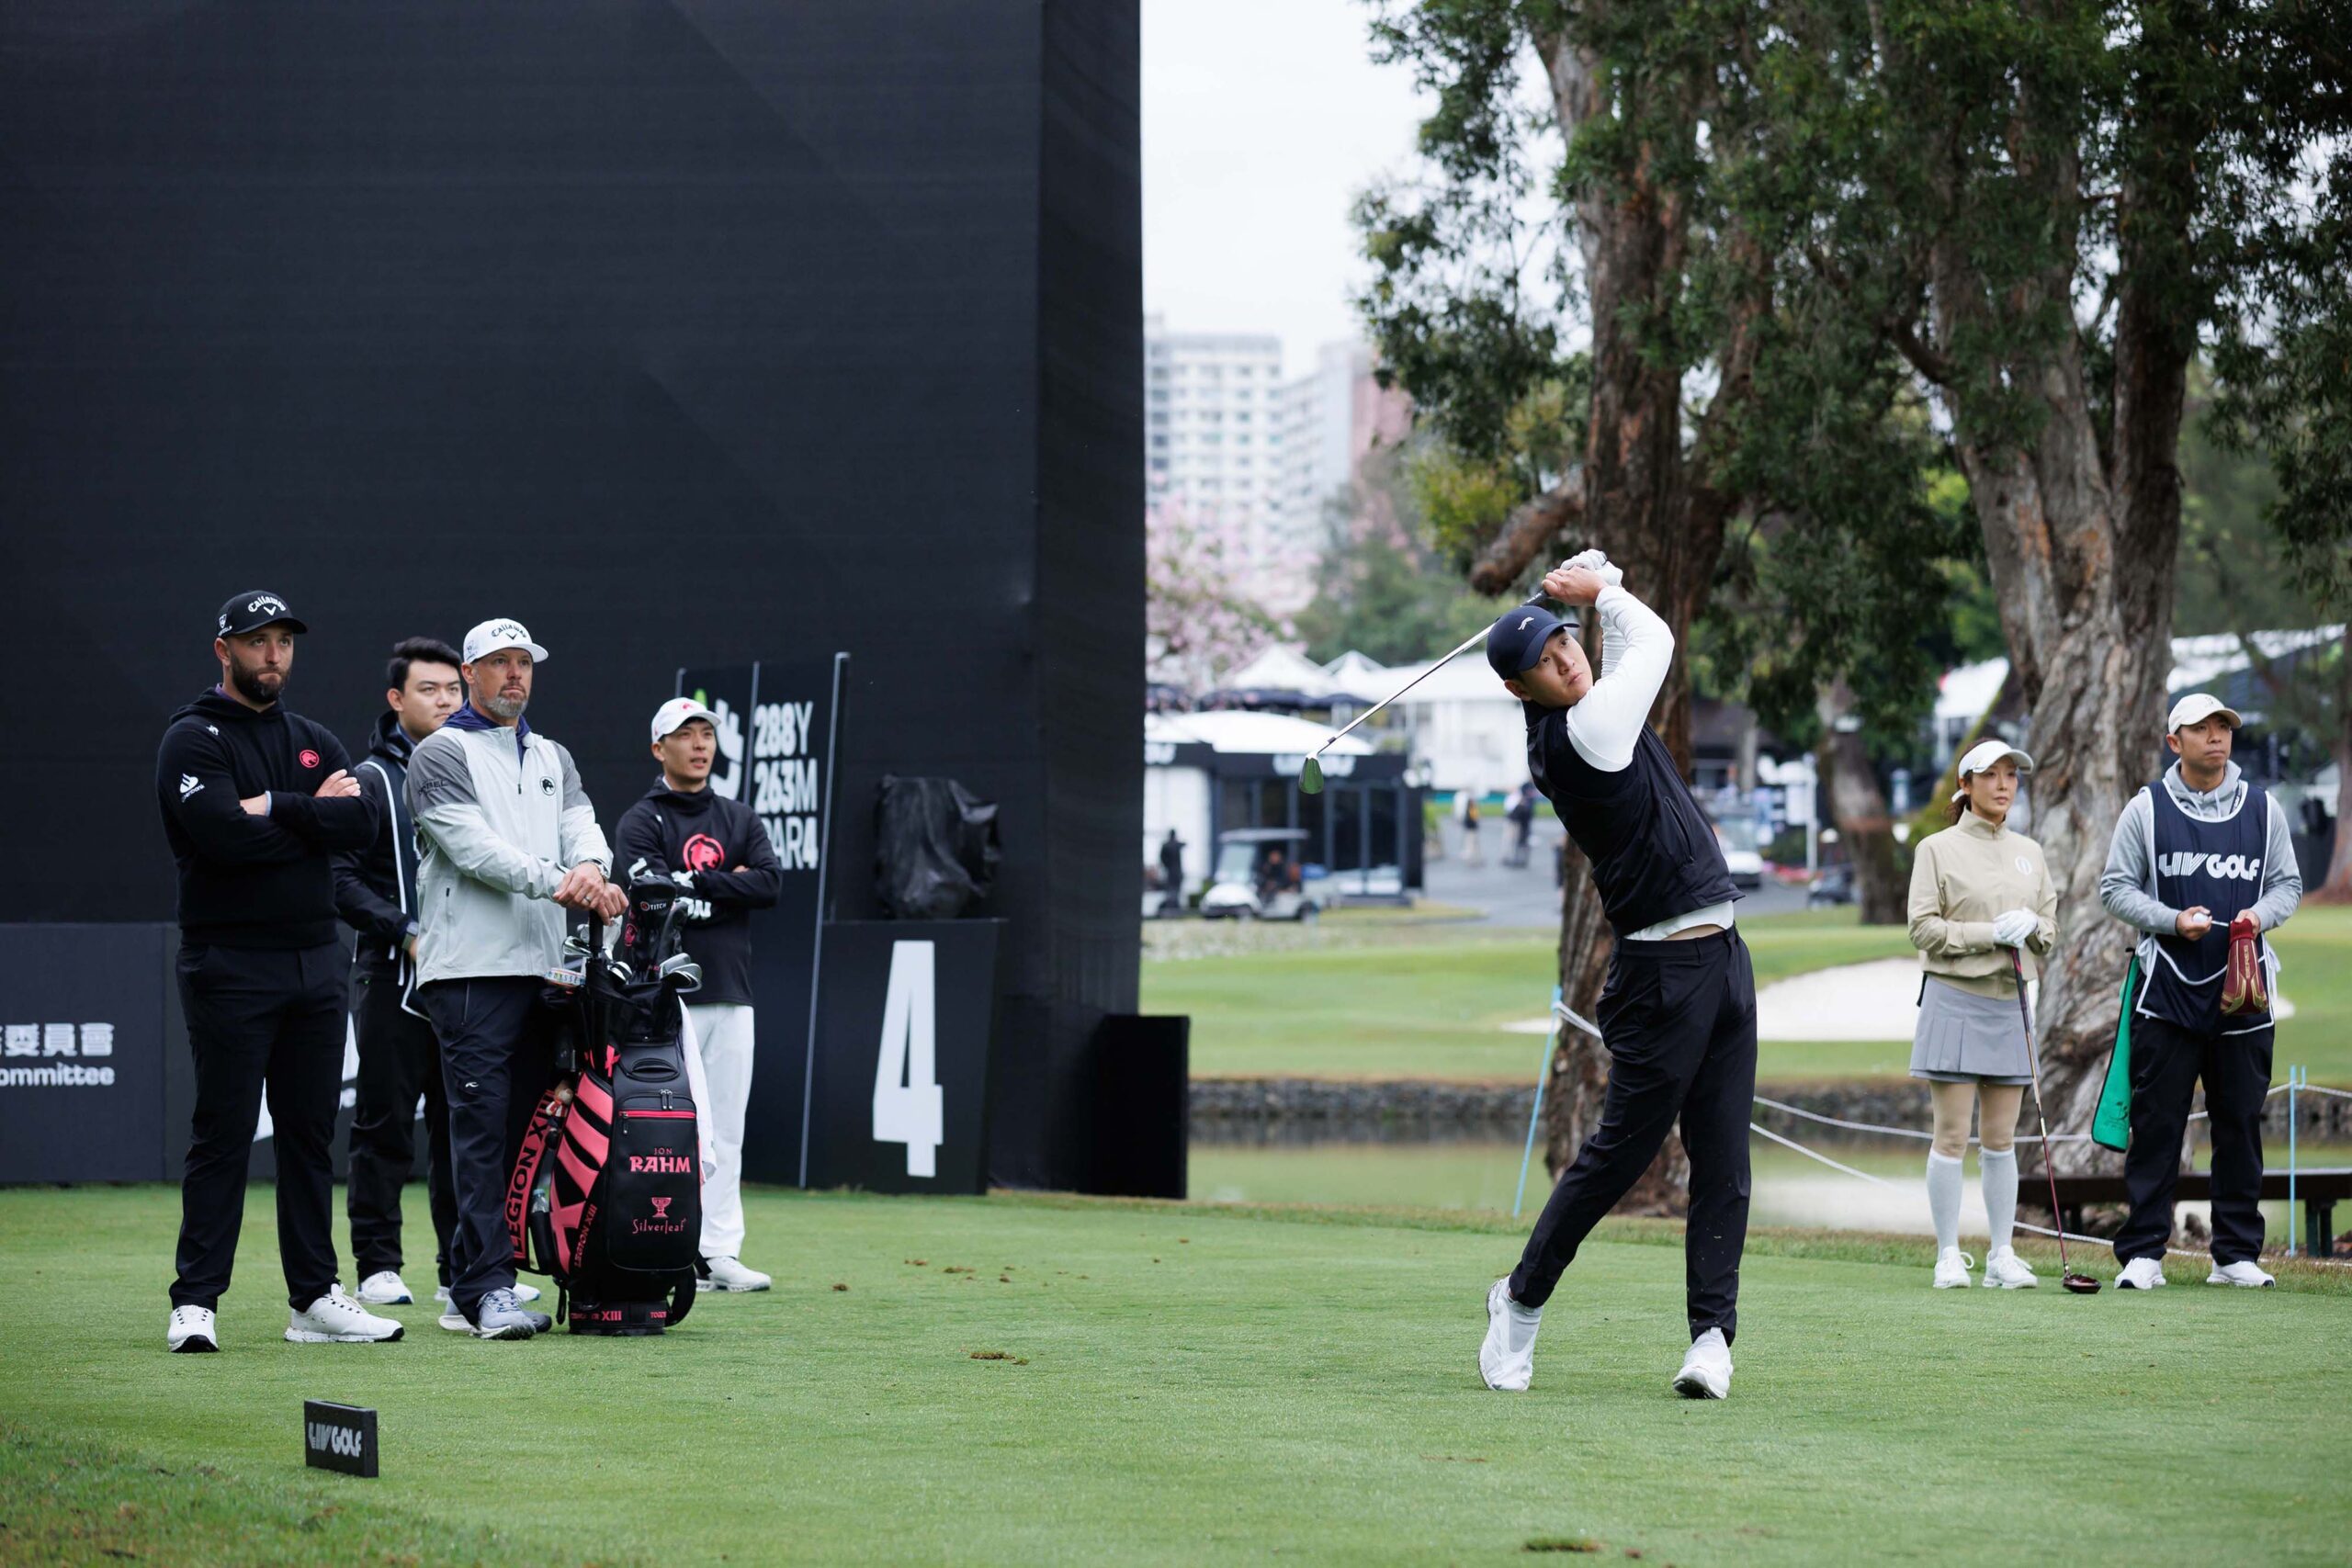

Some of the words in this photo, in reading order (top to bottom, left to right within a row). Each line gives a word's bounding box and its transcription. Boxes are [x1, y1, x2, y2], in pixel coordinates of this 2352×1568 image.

[248, 595, 286, 613] Callaway
[491, 624, 526, 637] Callaway
[753, 700, 814, 758] 288Y
[753, 758, 818, 813] 263M
[0, 1021, 116, 1058] 委員會
[873, 940, 944, 1178] 4
[0, 1061, 116, 1087] ommittee
[629, 1156, 692, 1173] RAHM
[506, 1148, 538, 1255] LEGION
[632, 1218, 685, 1235] Silverleaf
[602, 1310, 622, 1322] XIII
